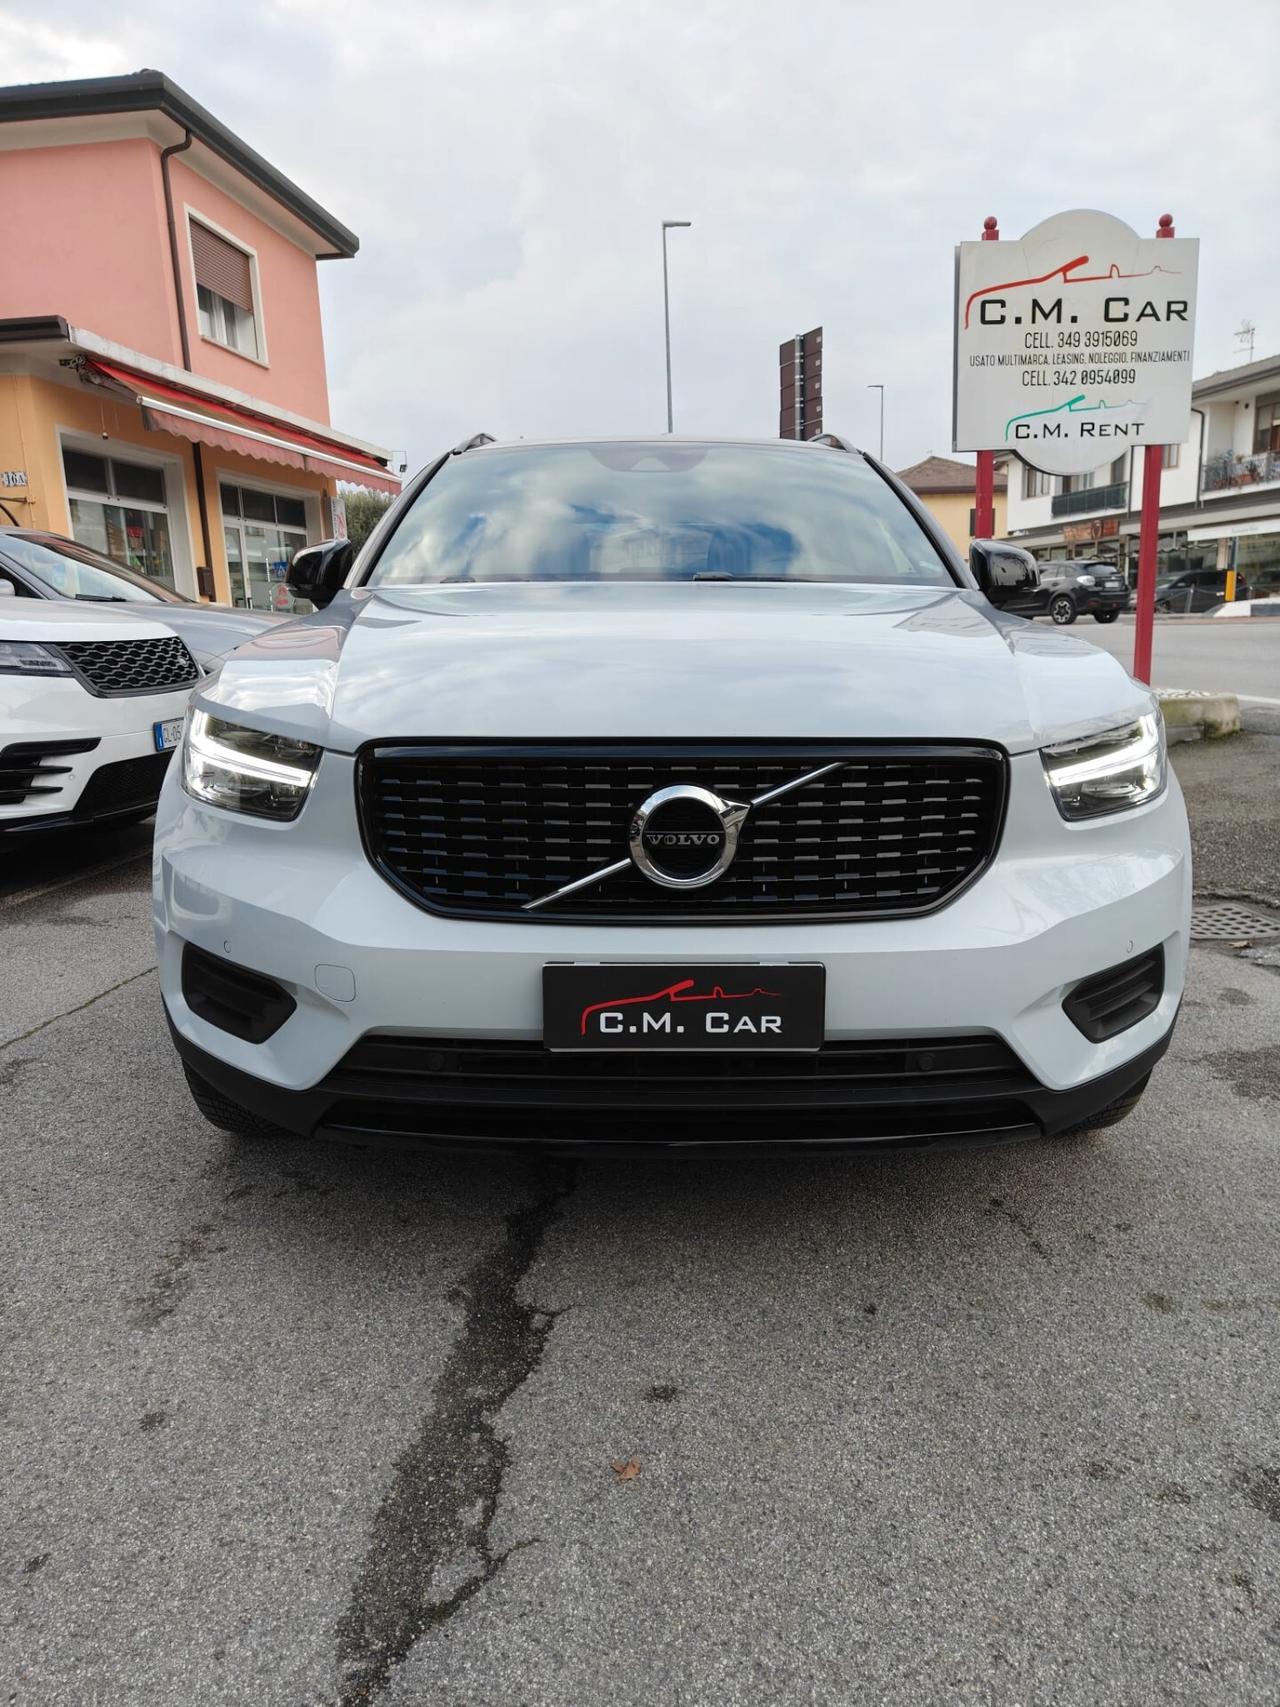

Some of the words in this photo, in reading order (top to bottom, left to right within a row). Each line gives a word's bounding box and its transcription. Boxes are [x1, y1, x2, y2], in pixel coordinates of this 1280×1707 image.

[980, 297, 1078, 325] C.M.
[1024, 332, 1054, 349] CELL.
[1057, 331, 1081, 348] 349
[1084, 330, 1138, 347] 3915069
[969, 354, 996, 367] USATO
[1131, 350, 1191, 363] FINANZIAMENTI
[1022, 370, 1051, 386] CELL.
[1053, 370, 1077, 386] 342
[1081, 368, 1136, 385] 0954099
[1015, 423, 1069, 439] C.M.
[646, 834, 720, 846] VOLVO
[599, 1011, 685, 1034] C.M.
